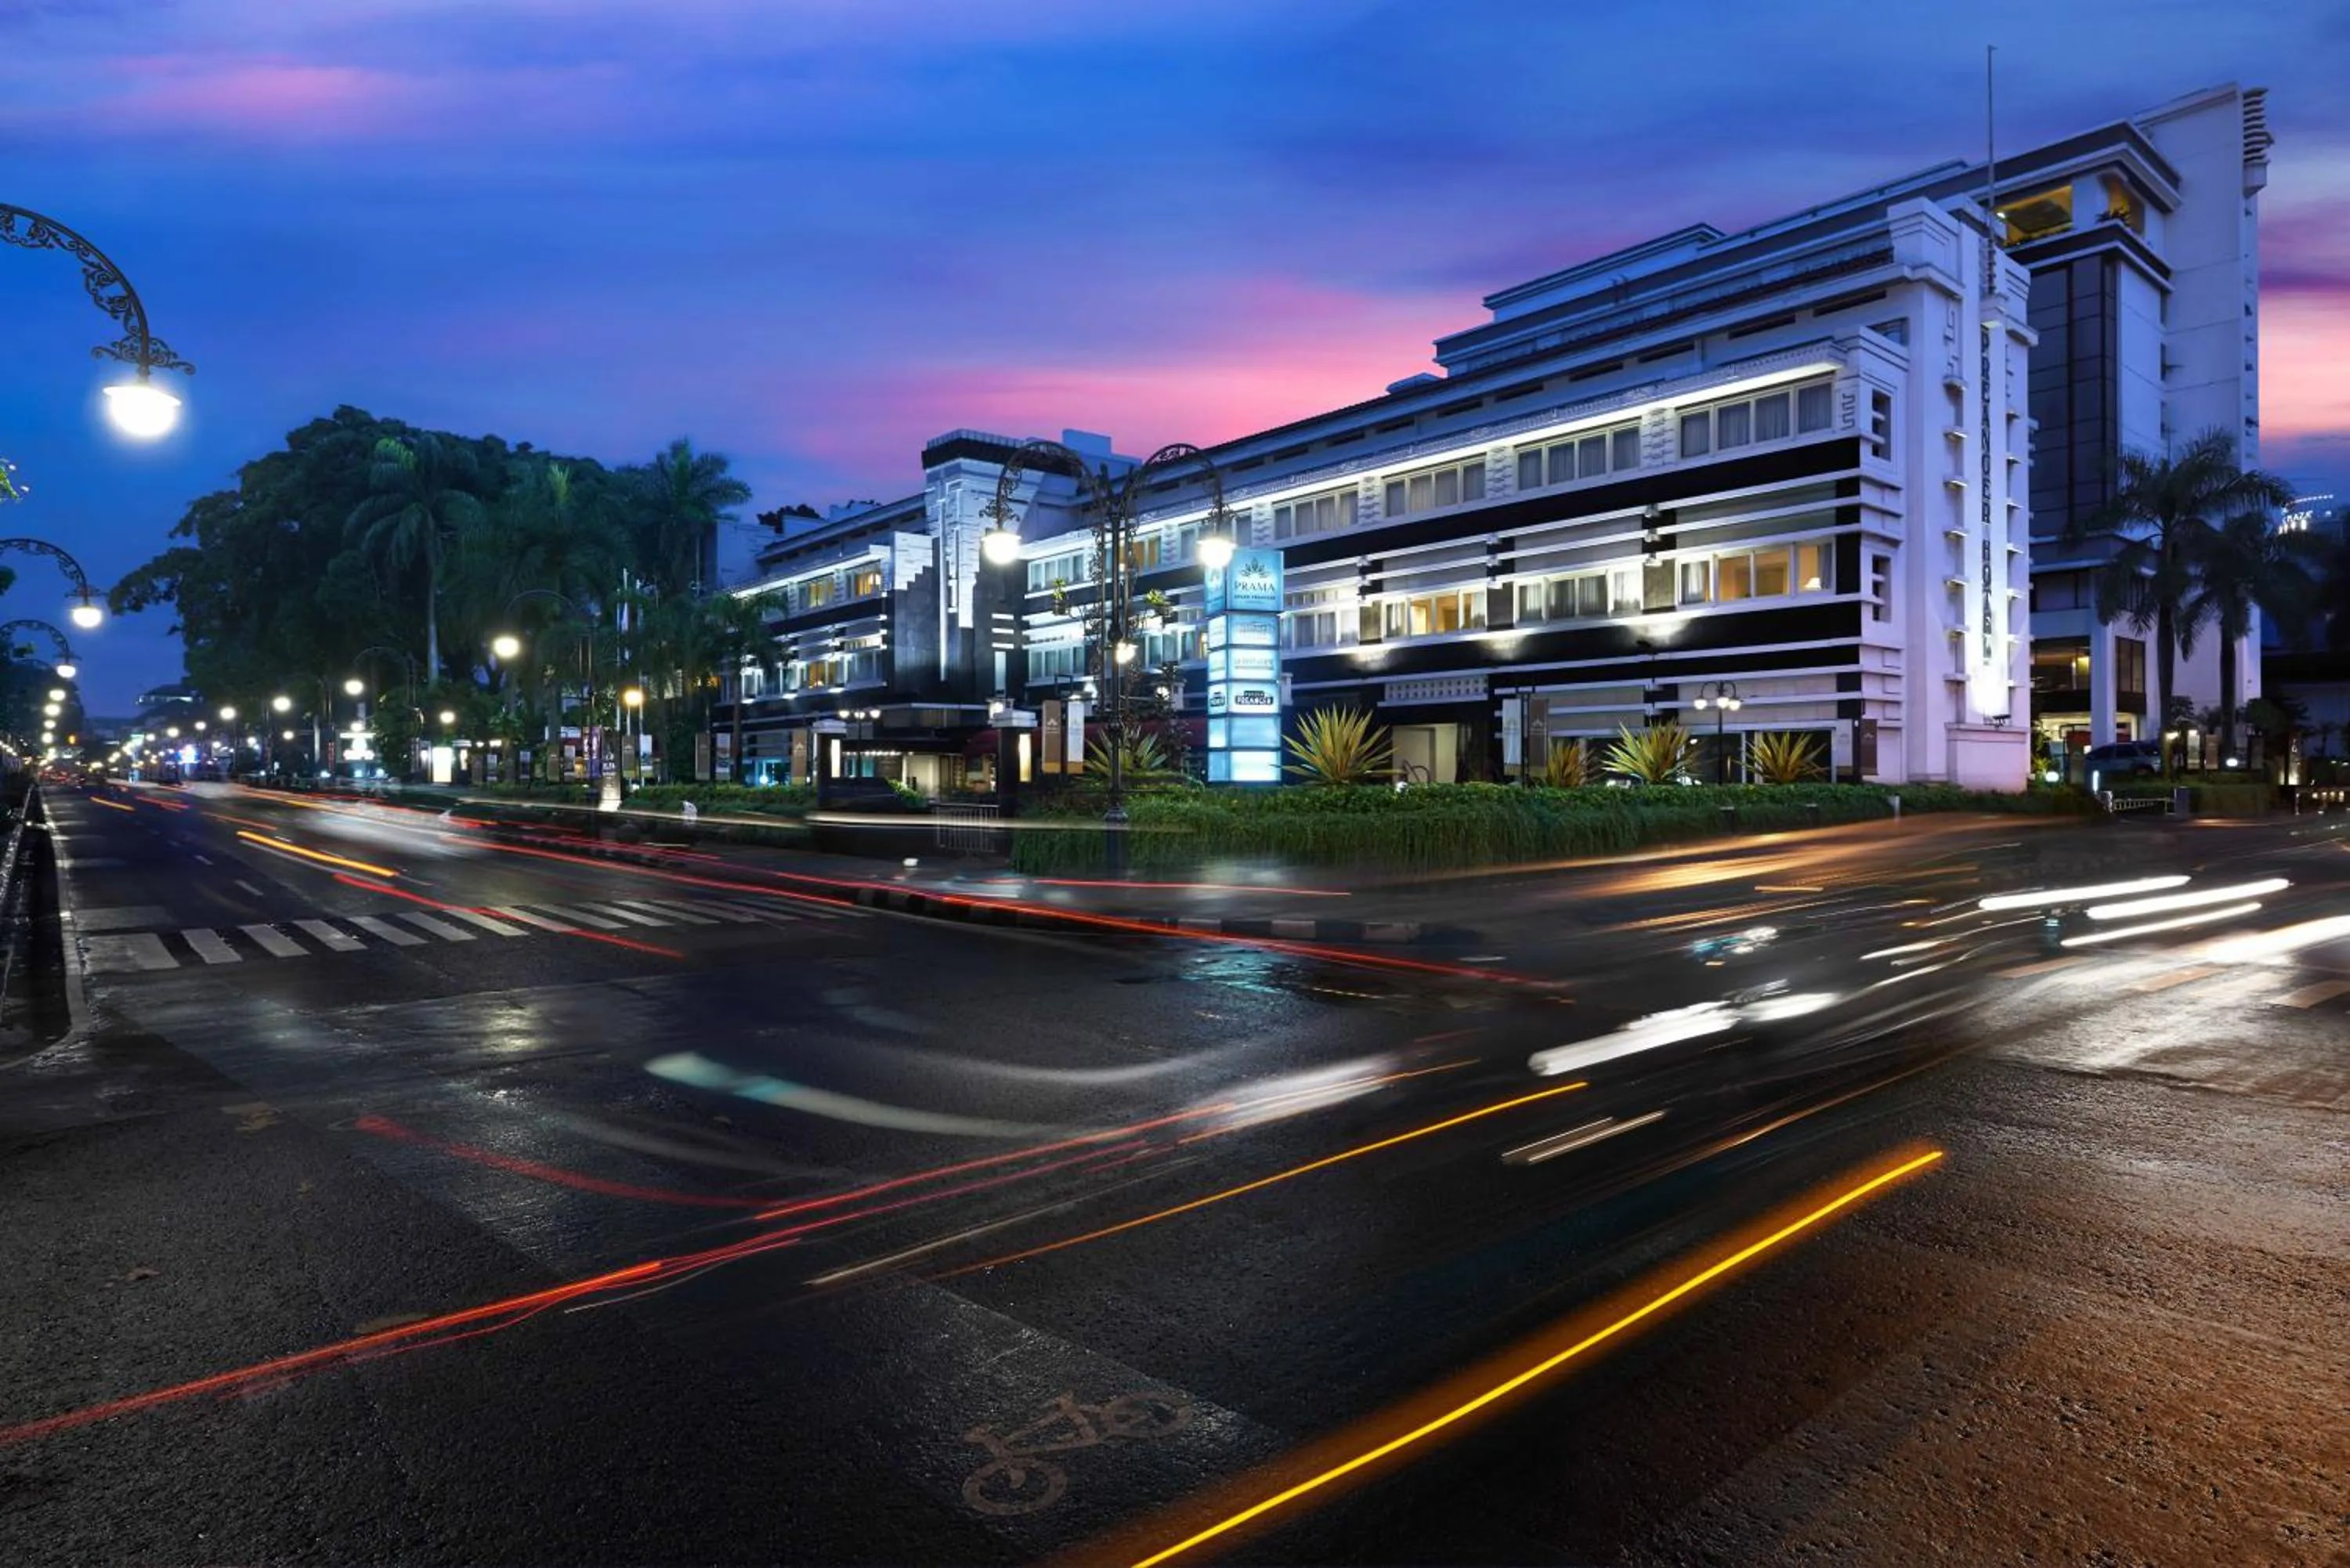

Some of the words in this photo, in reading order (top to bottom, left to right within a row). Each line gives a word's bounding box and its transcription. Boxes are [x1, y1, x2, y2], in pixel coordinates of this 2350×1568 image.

[1981, 329, 1990, 523] PREANGER
[1234, 581, 1276, 593] PRAMA
[1982, 540, 1991, 659] HOTEL
